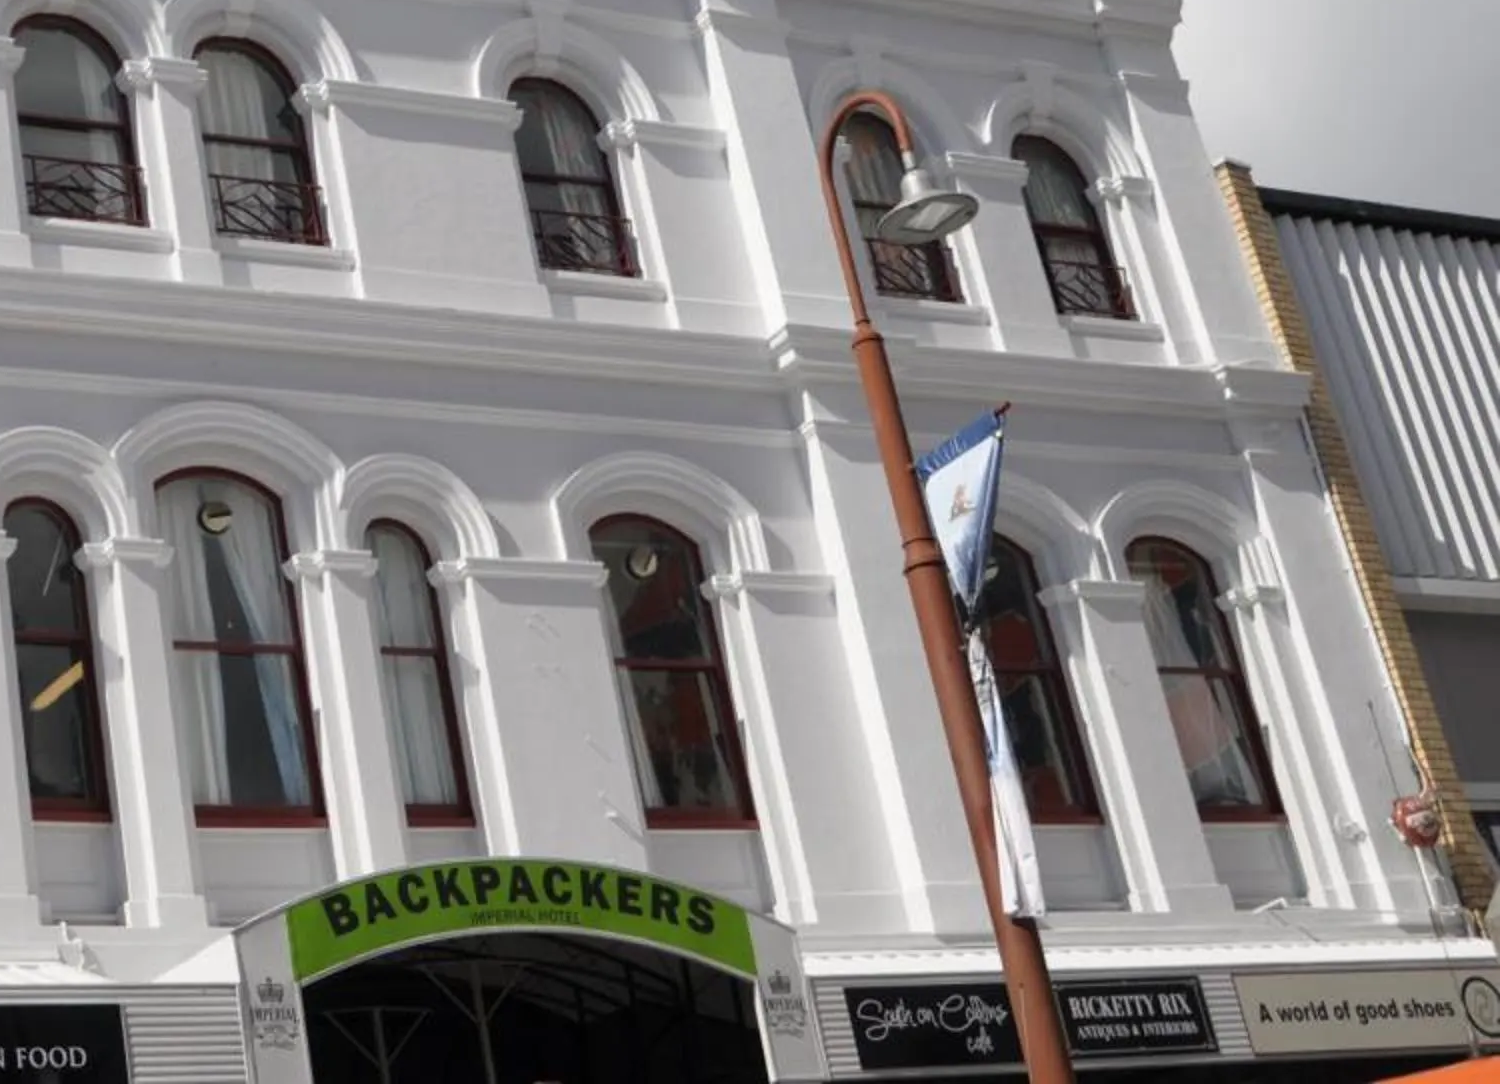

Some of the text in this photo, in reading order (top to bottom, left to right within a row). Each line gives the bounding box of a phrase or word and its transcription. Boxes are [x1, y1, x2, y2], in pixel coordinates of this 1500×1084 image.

[320, 865, 717, 937] BACKPACKERS
[1068, 992, 1193, 1020] RICKETTY RIX
[1259, 997, 1455, 1025] A world of good shoes
[15, 1046, 88, 1070] FOOD
